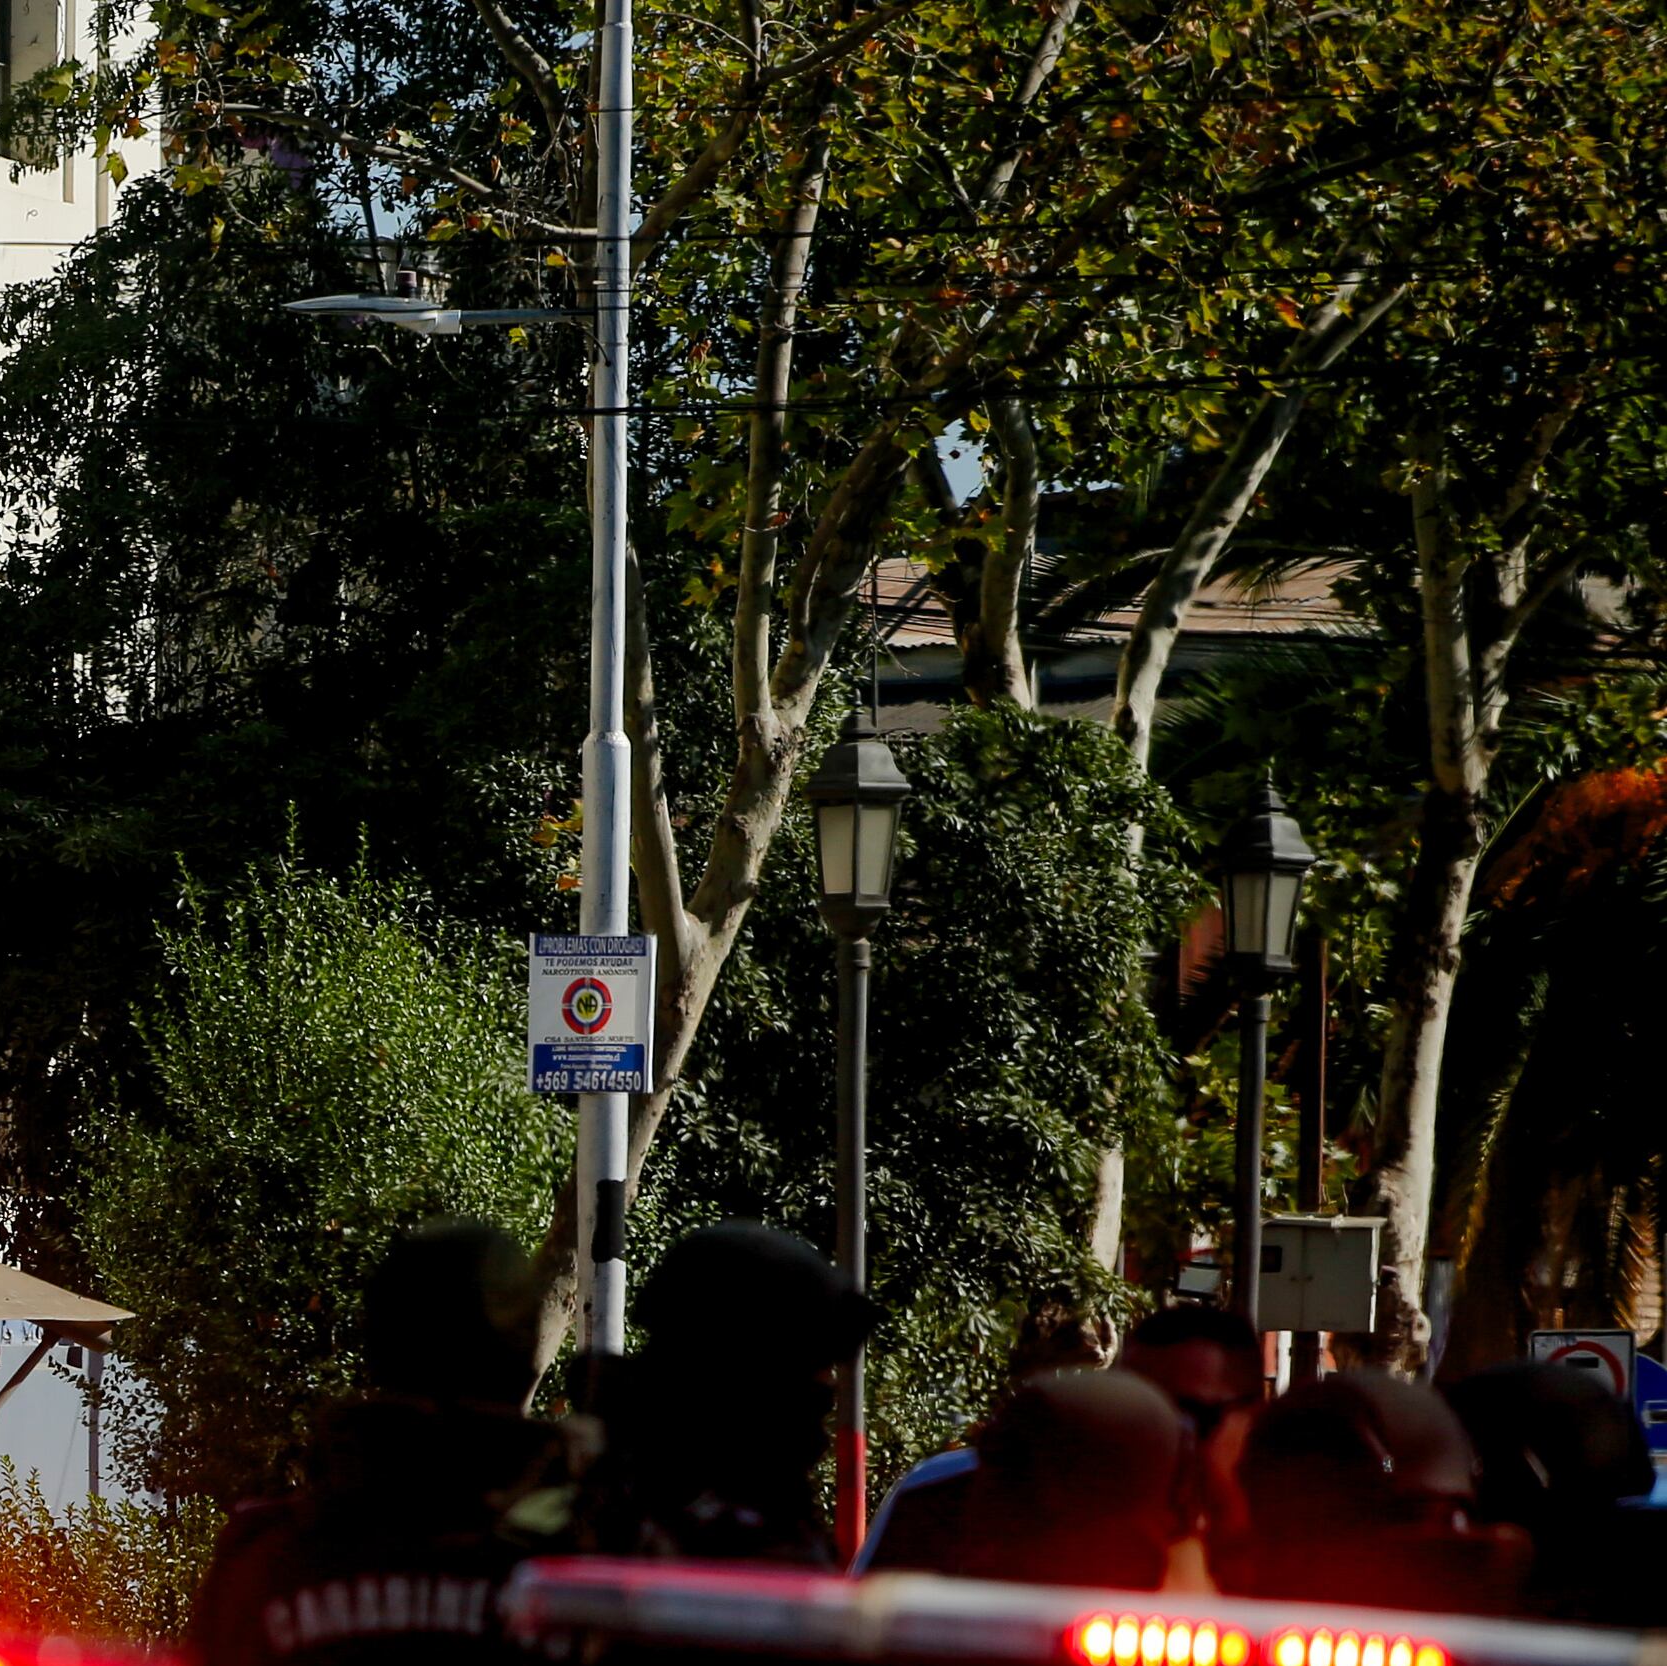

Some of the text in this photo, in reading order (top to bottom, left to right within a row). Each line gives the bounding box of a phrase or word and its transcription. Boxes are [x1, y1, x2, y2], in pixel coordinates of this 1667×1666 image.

[589, 936, 606, 954] CON
[545, 958, 633, 967] TE PODEMOS AYUDAR
[536, 1071, 641, 1090] +569 54614550
